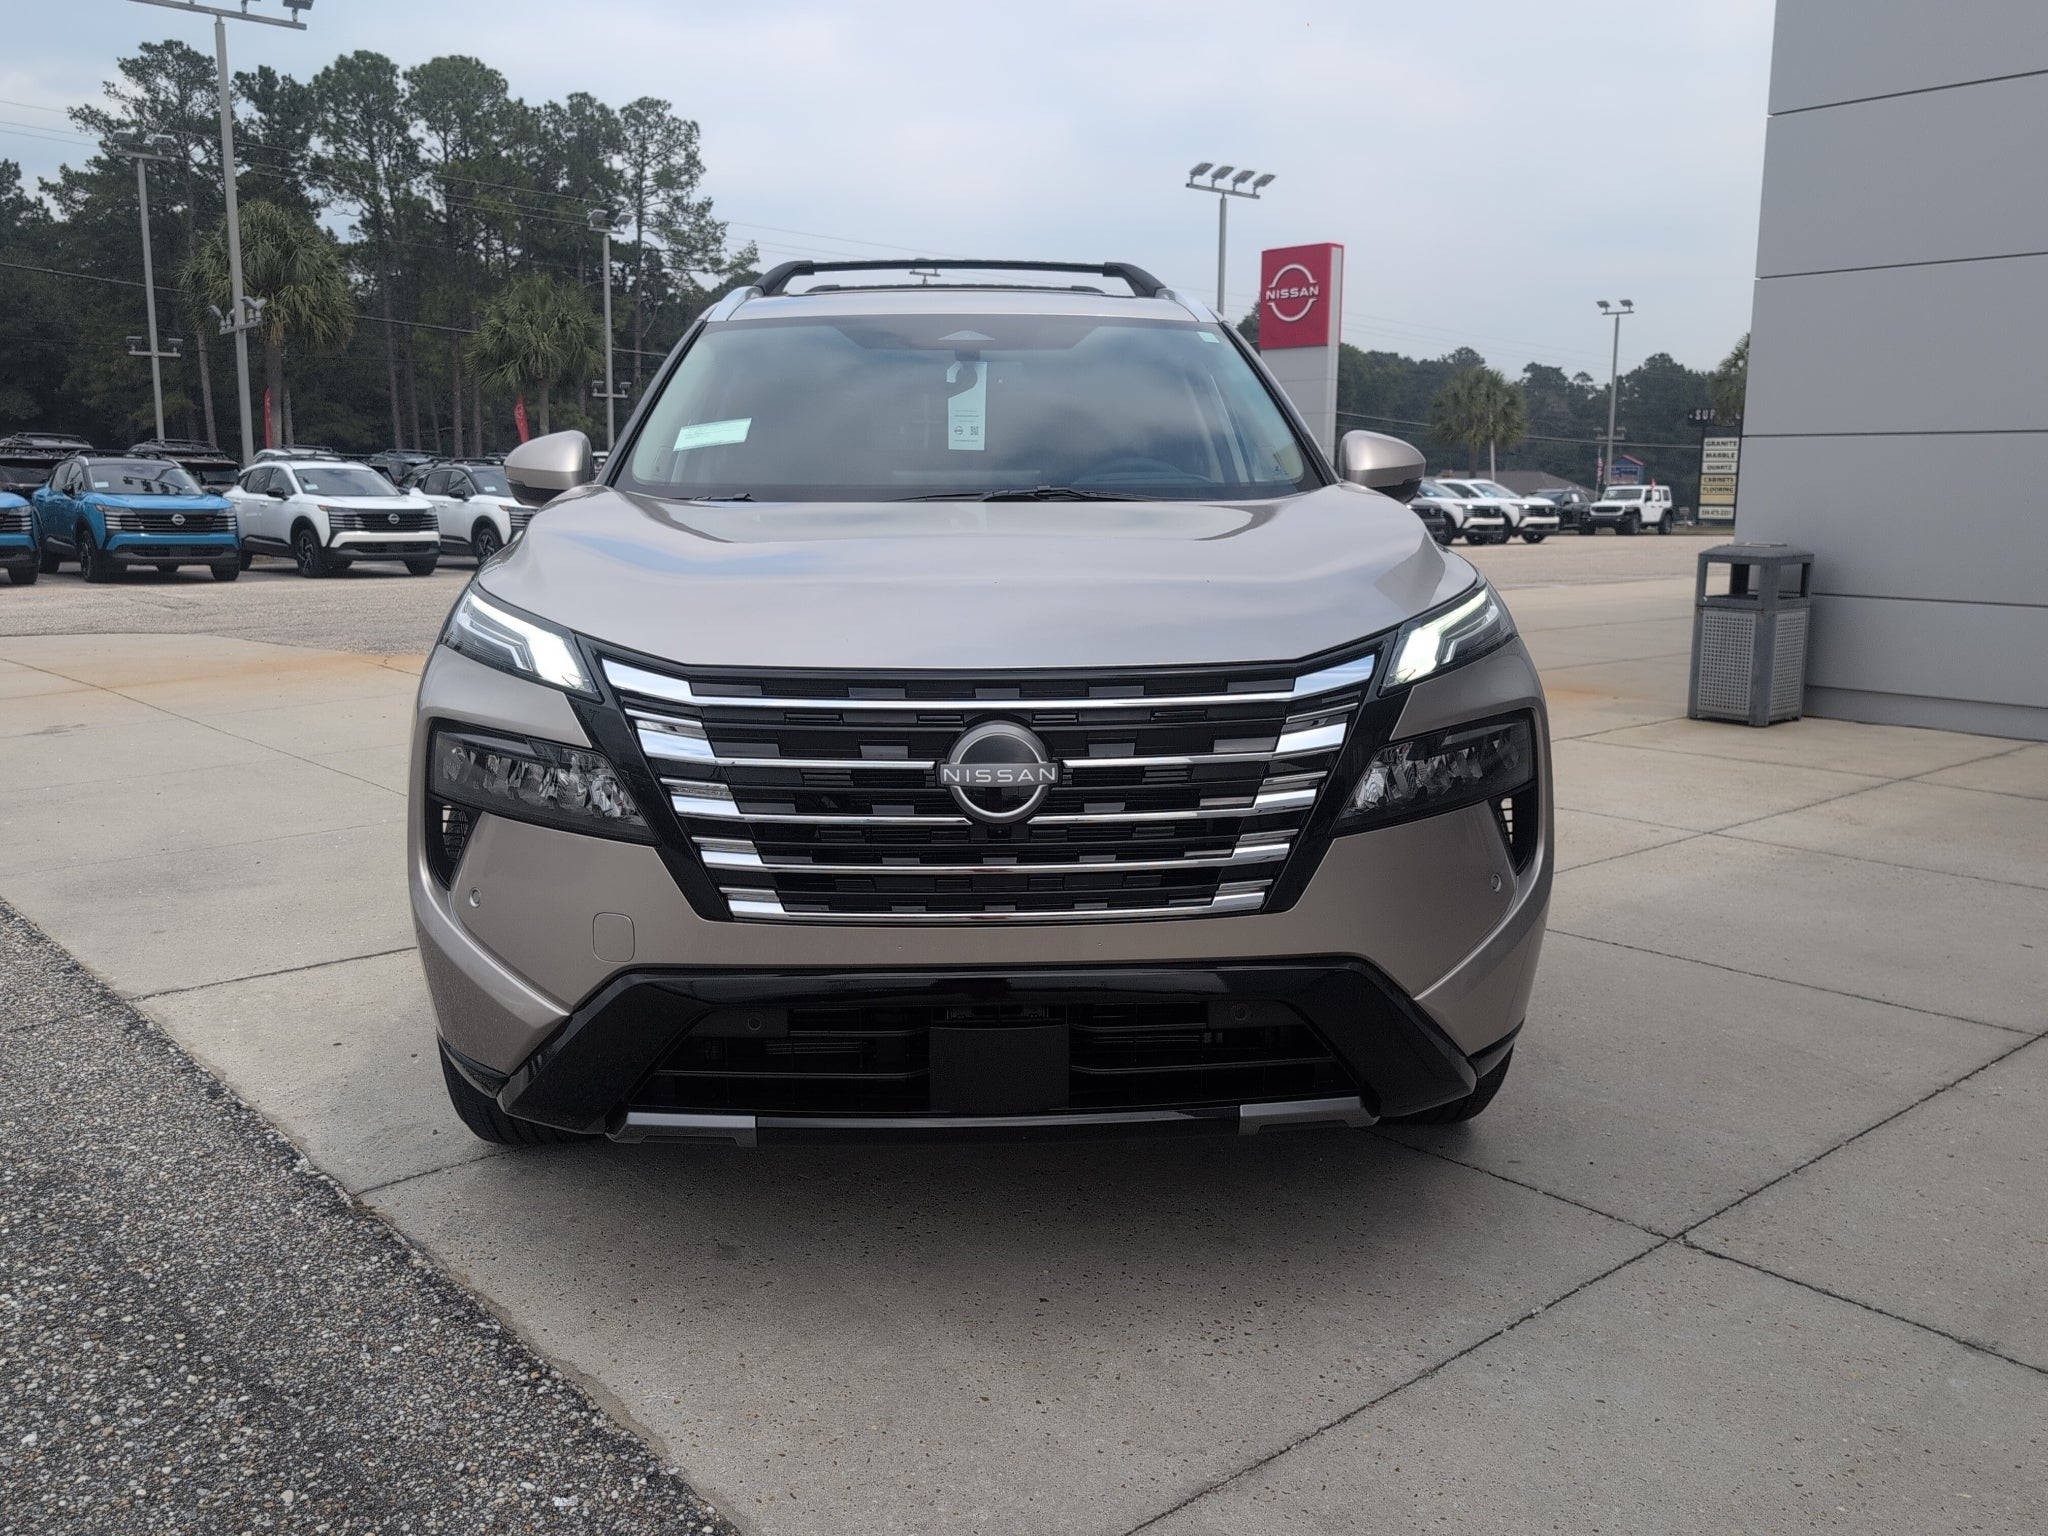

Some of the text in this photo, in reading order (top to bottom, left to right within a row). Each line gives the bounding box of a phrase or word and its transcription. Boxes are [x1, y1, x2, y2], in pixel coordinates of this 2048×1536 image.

[1265, 286, 1319, 300] NISSAN
[1705, 439, 1737, 447] GRANITE
[943, 767, 1055, 783] NISSAN
